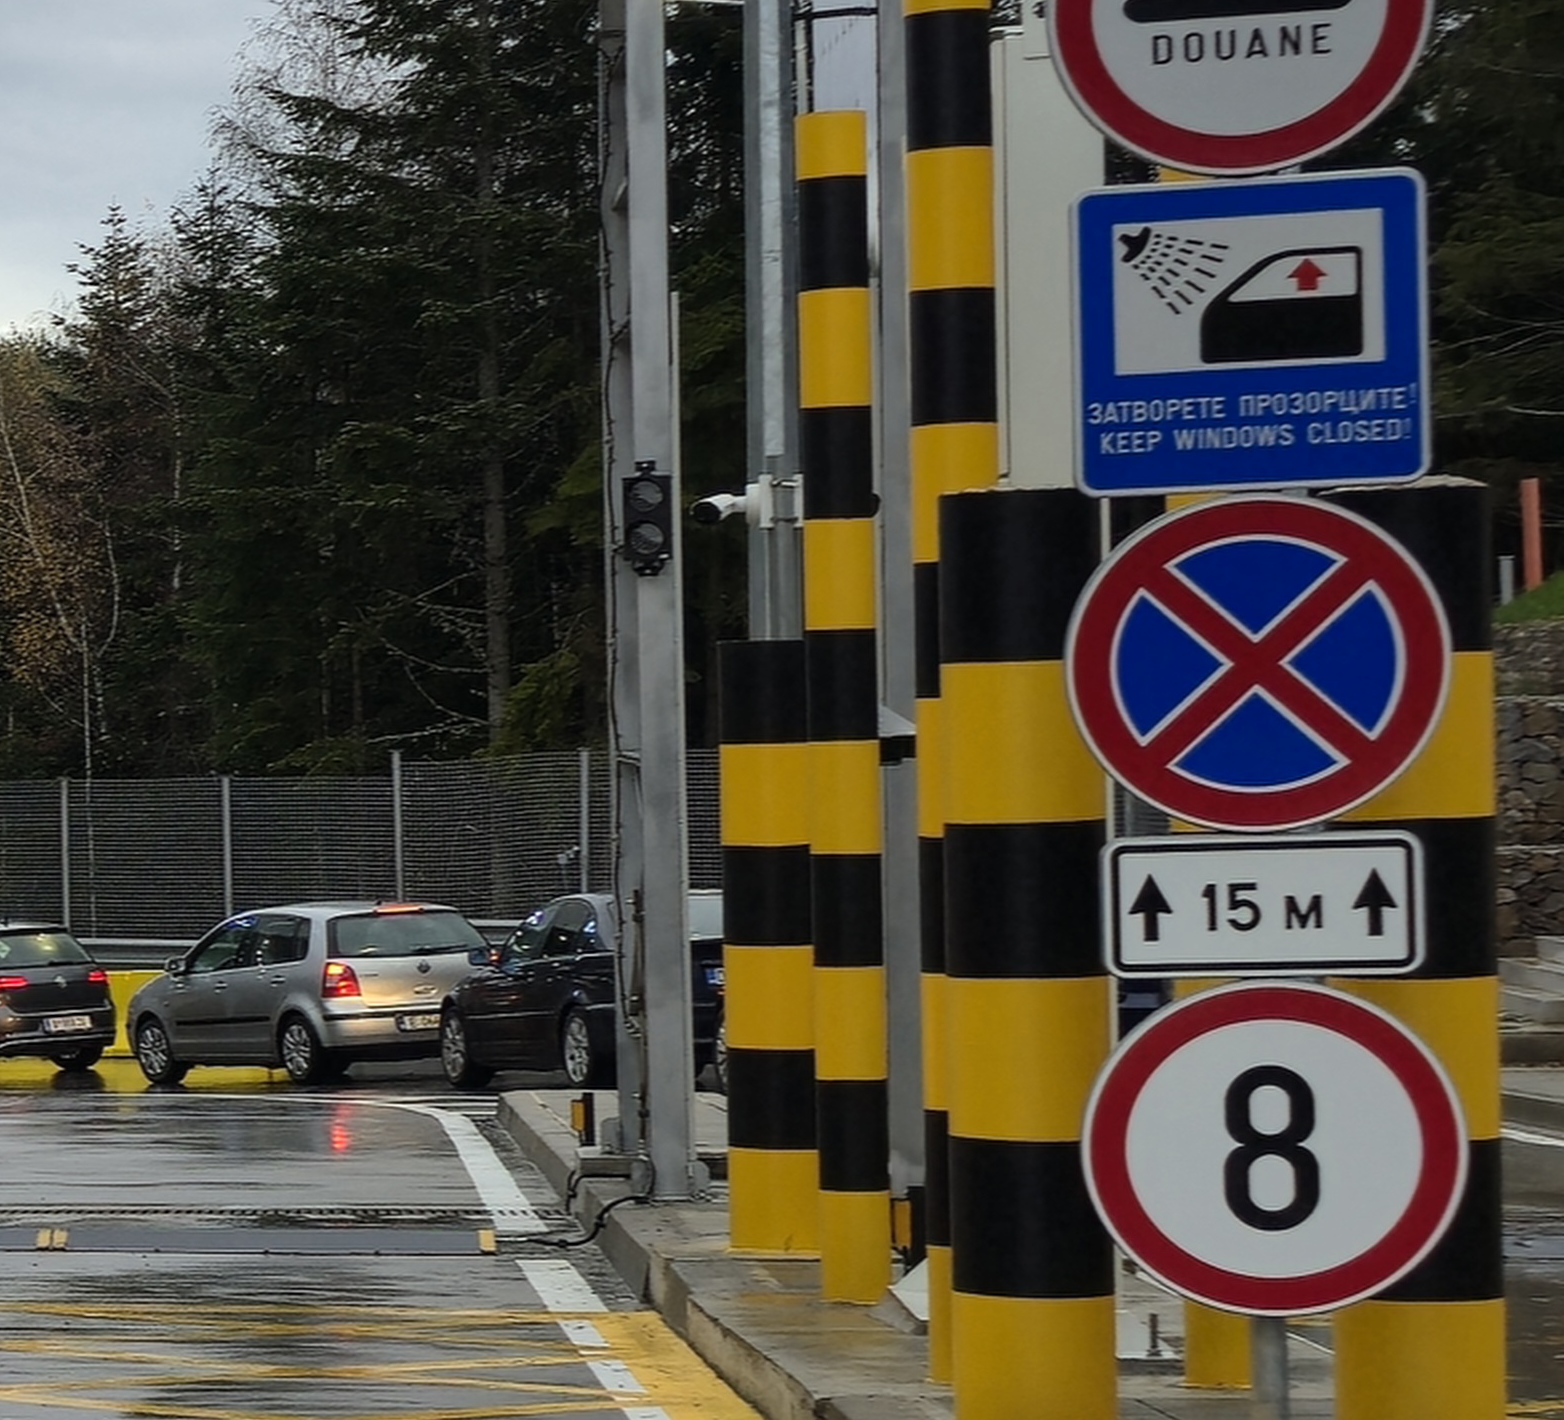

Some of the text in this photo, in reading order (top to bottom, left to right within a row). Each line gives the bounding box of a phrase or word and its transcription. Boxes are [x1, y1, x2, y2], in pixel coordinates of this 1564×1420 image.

[1151, 23, 1333, 66] DOUANE
[1087, 383, 1418, 425] ЗАТВОРЕТЕ ПРОЗОРЦИТЕ!
[1099, 417, 1412, 455] KEEP WINDOWS CLOSED!
[1201, 882, 1262, 932] 15
[1223, 1065, 1321, 1232] 8
